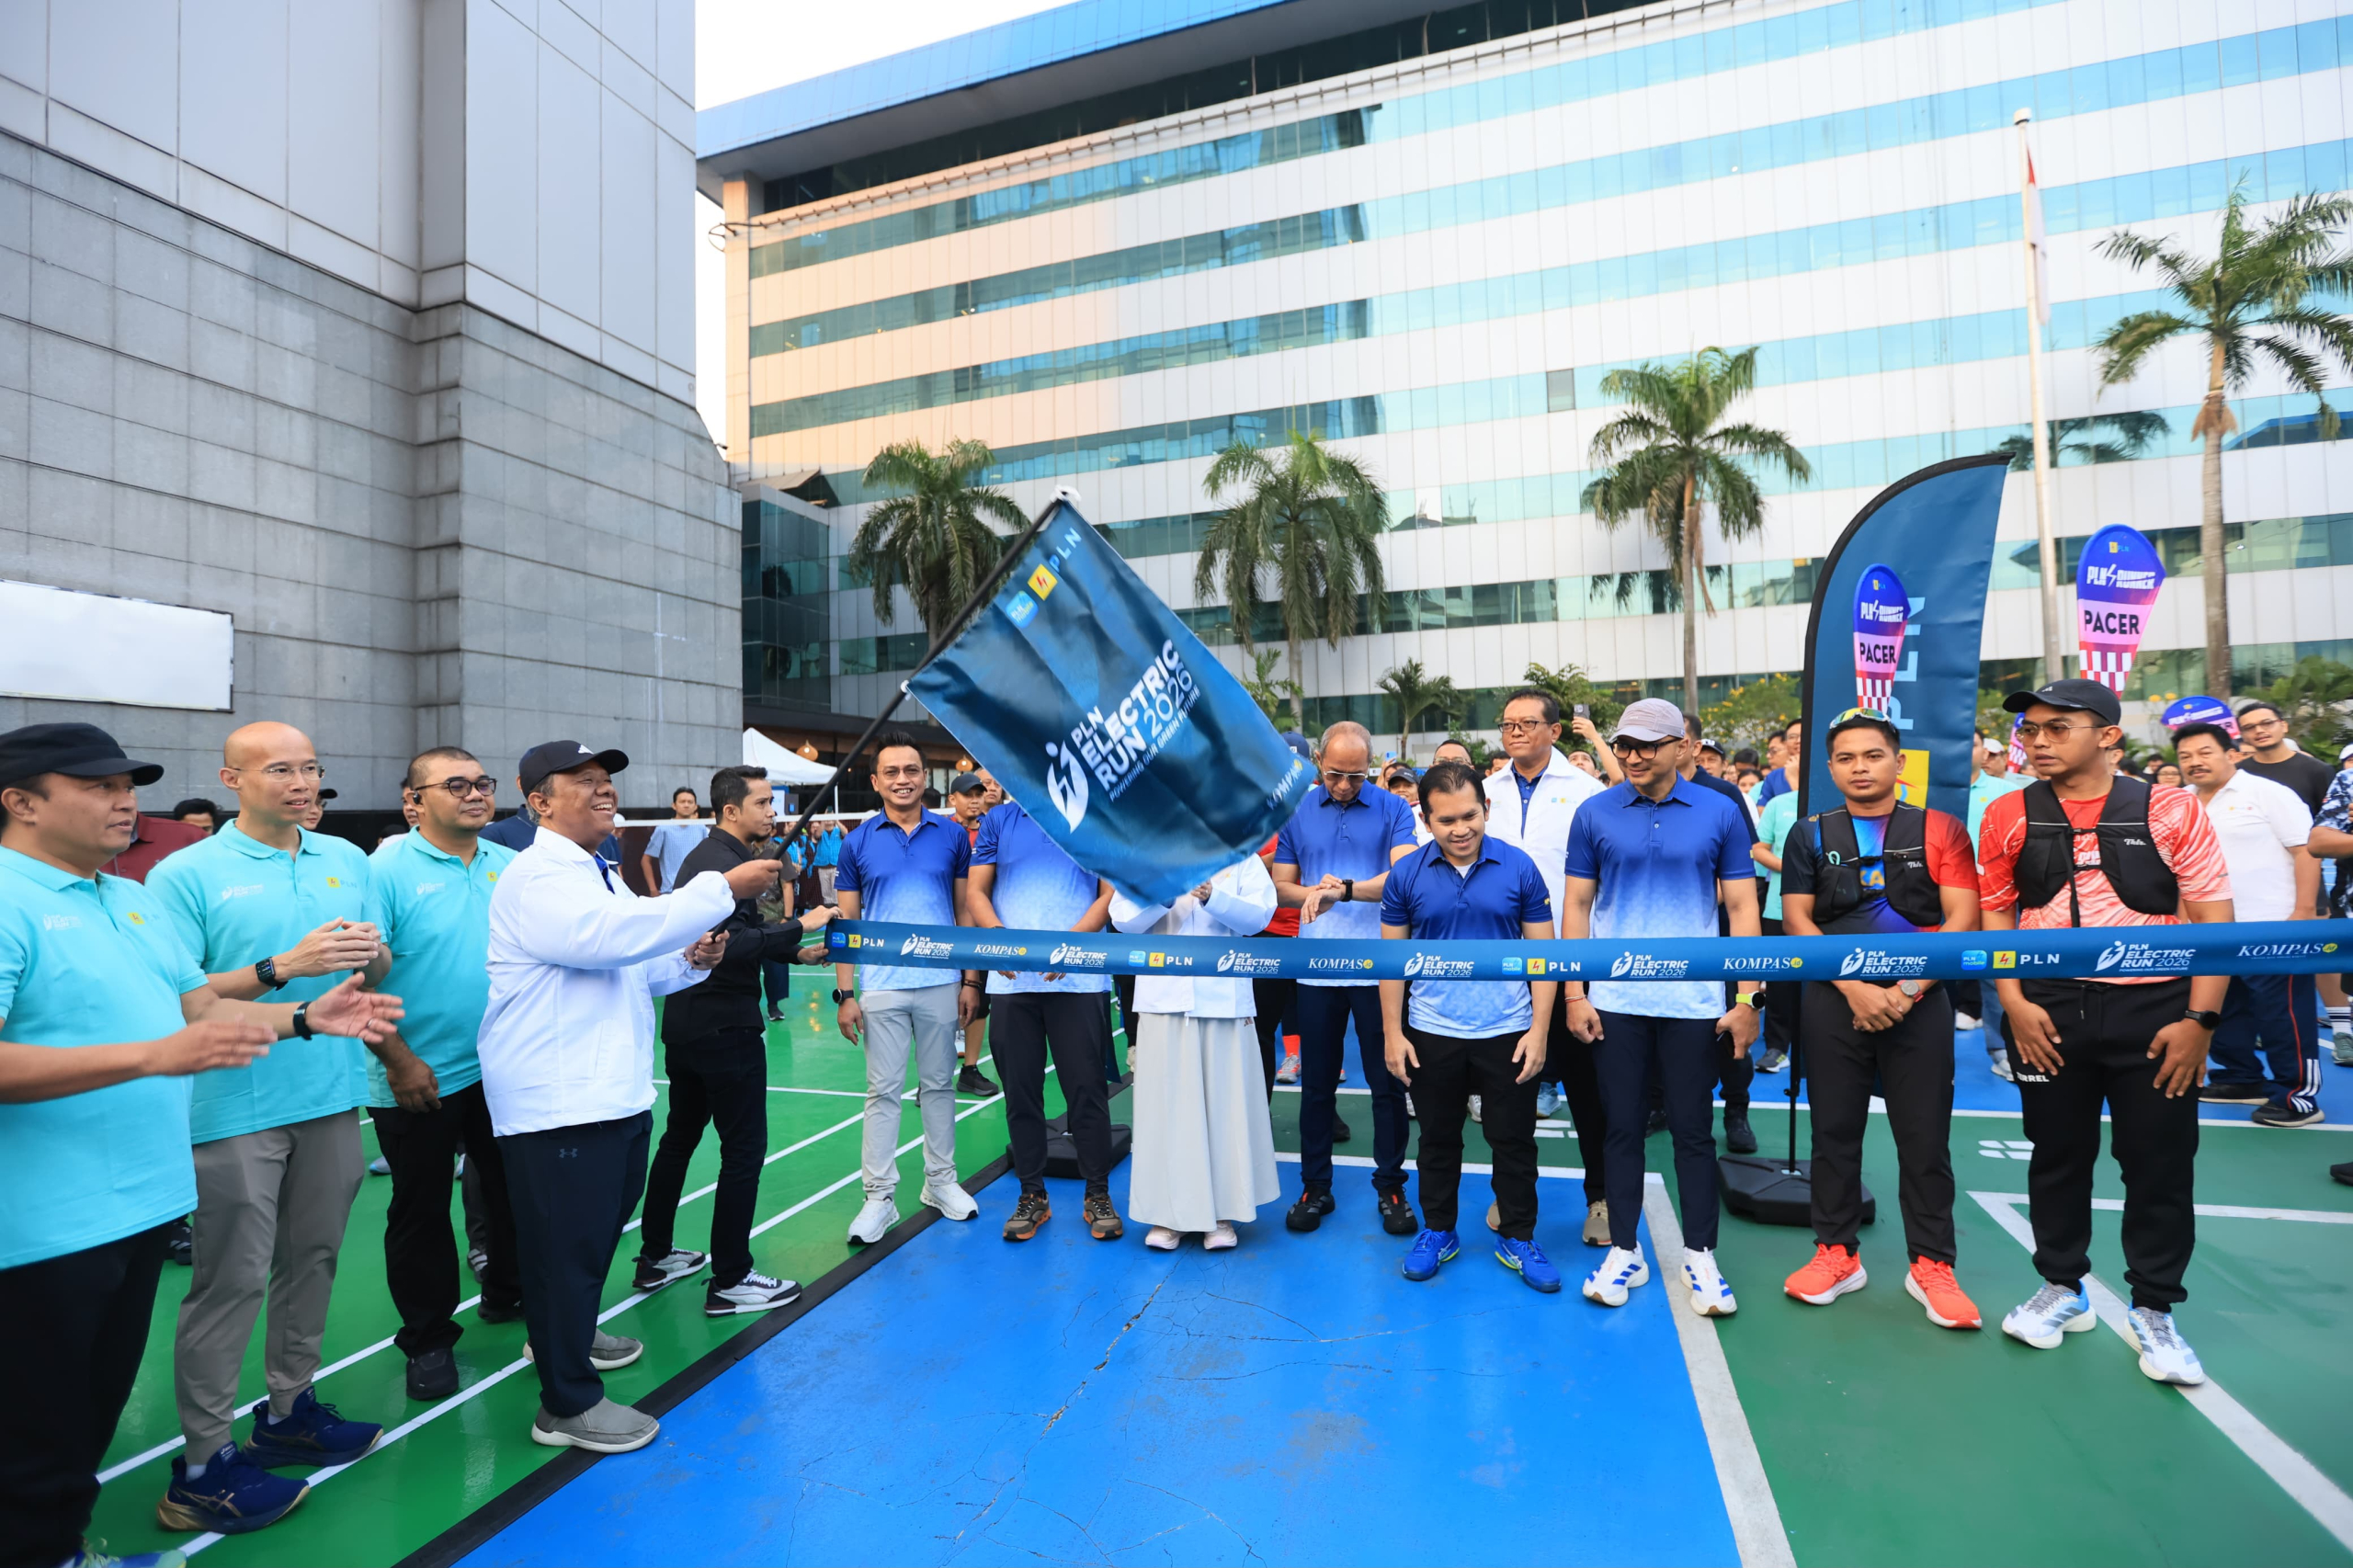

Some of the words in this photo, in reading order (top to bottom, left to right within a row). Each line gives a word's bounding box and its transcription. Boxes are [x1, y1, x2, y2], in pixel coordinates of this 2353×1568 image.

[1050, 528, 1081, 572] PLN
[2086, 566, 2108, 585] PLN
[2116, 570, 2156, 589] RUNNER
[1860, 602, 1874, 620] PLN
[1879, 605, 1904, 622] RUNNER
[2085, 610, 2140, 634] PACER
[1860, 642, 1896, 664] PACER
[1081, 640, 1179, 770] ELECTRIC
[1070, 706, 1103, 748] PLN
[1094, 726, 1147, 791] RUN
[1143, 662, 1192, 739] 2026
[1108, 761, 1144, 802] POWERING
[1142, 744, 1158, 766] OUR
[1157, 719, 1180, 749] GREEN
[863, 937, 884, 947] PLN
[917, 942, 954, 950] ELECTRIC
[2020, 954, 2060, 965] PLN
[2125, 949, 2196, 960] ELECTRIC
[1166, 956, 1193, 965] PLN
[1549, 961, 1580, 971] PLN
[1633, 960, 1689, 969] ELECTRIC
[1865, 956, 1928, 966] ELECTRIC
[2120, 959, 2154, 968] RUN
[2155, 958, 2191, 967] 2026
[1862, 966, 1892, 974] RUN
[1893, 965, 1925, 973] 2026
